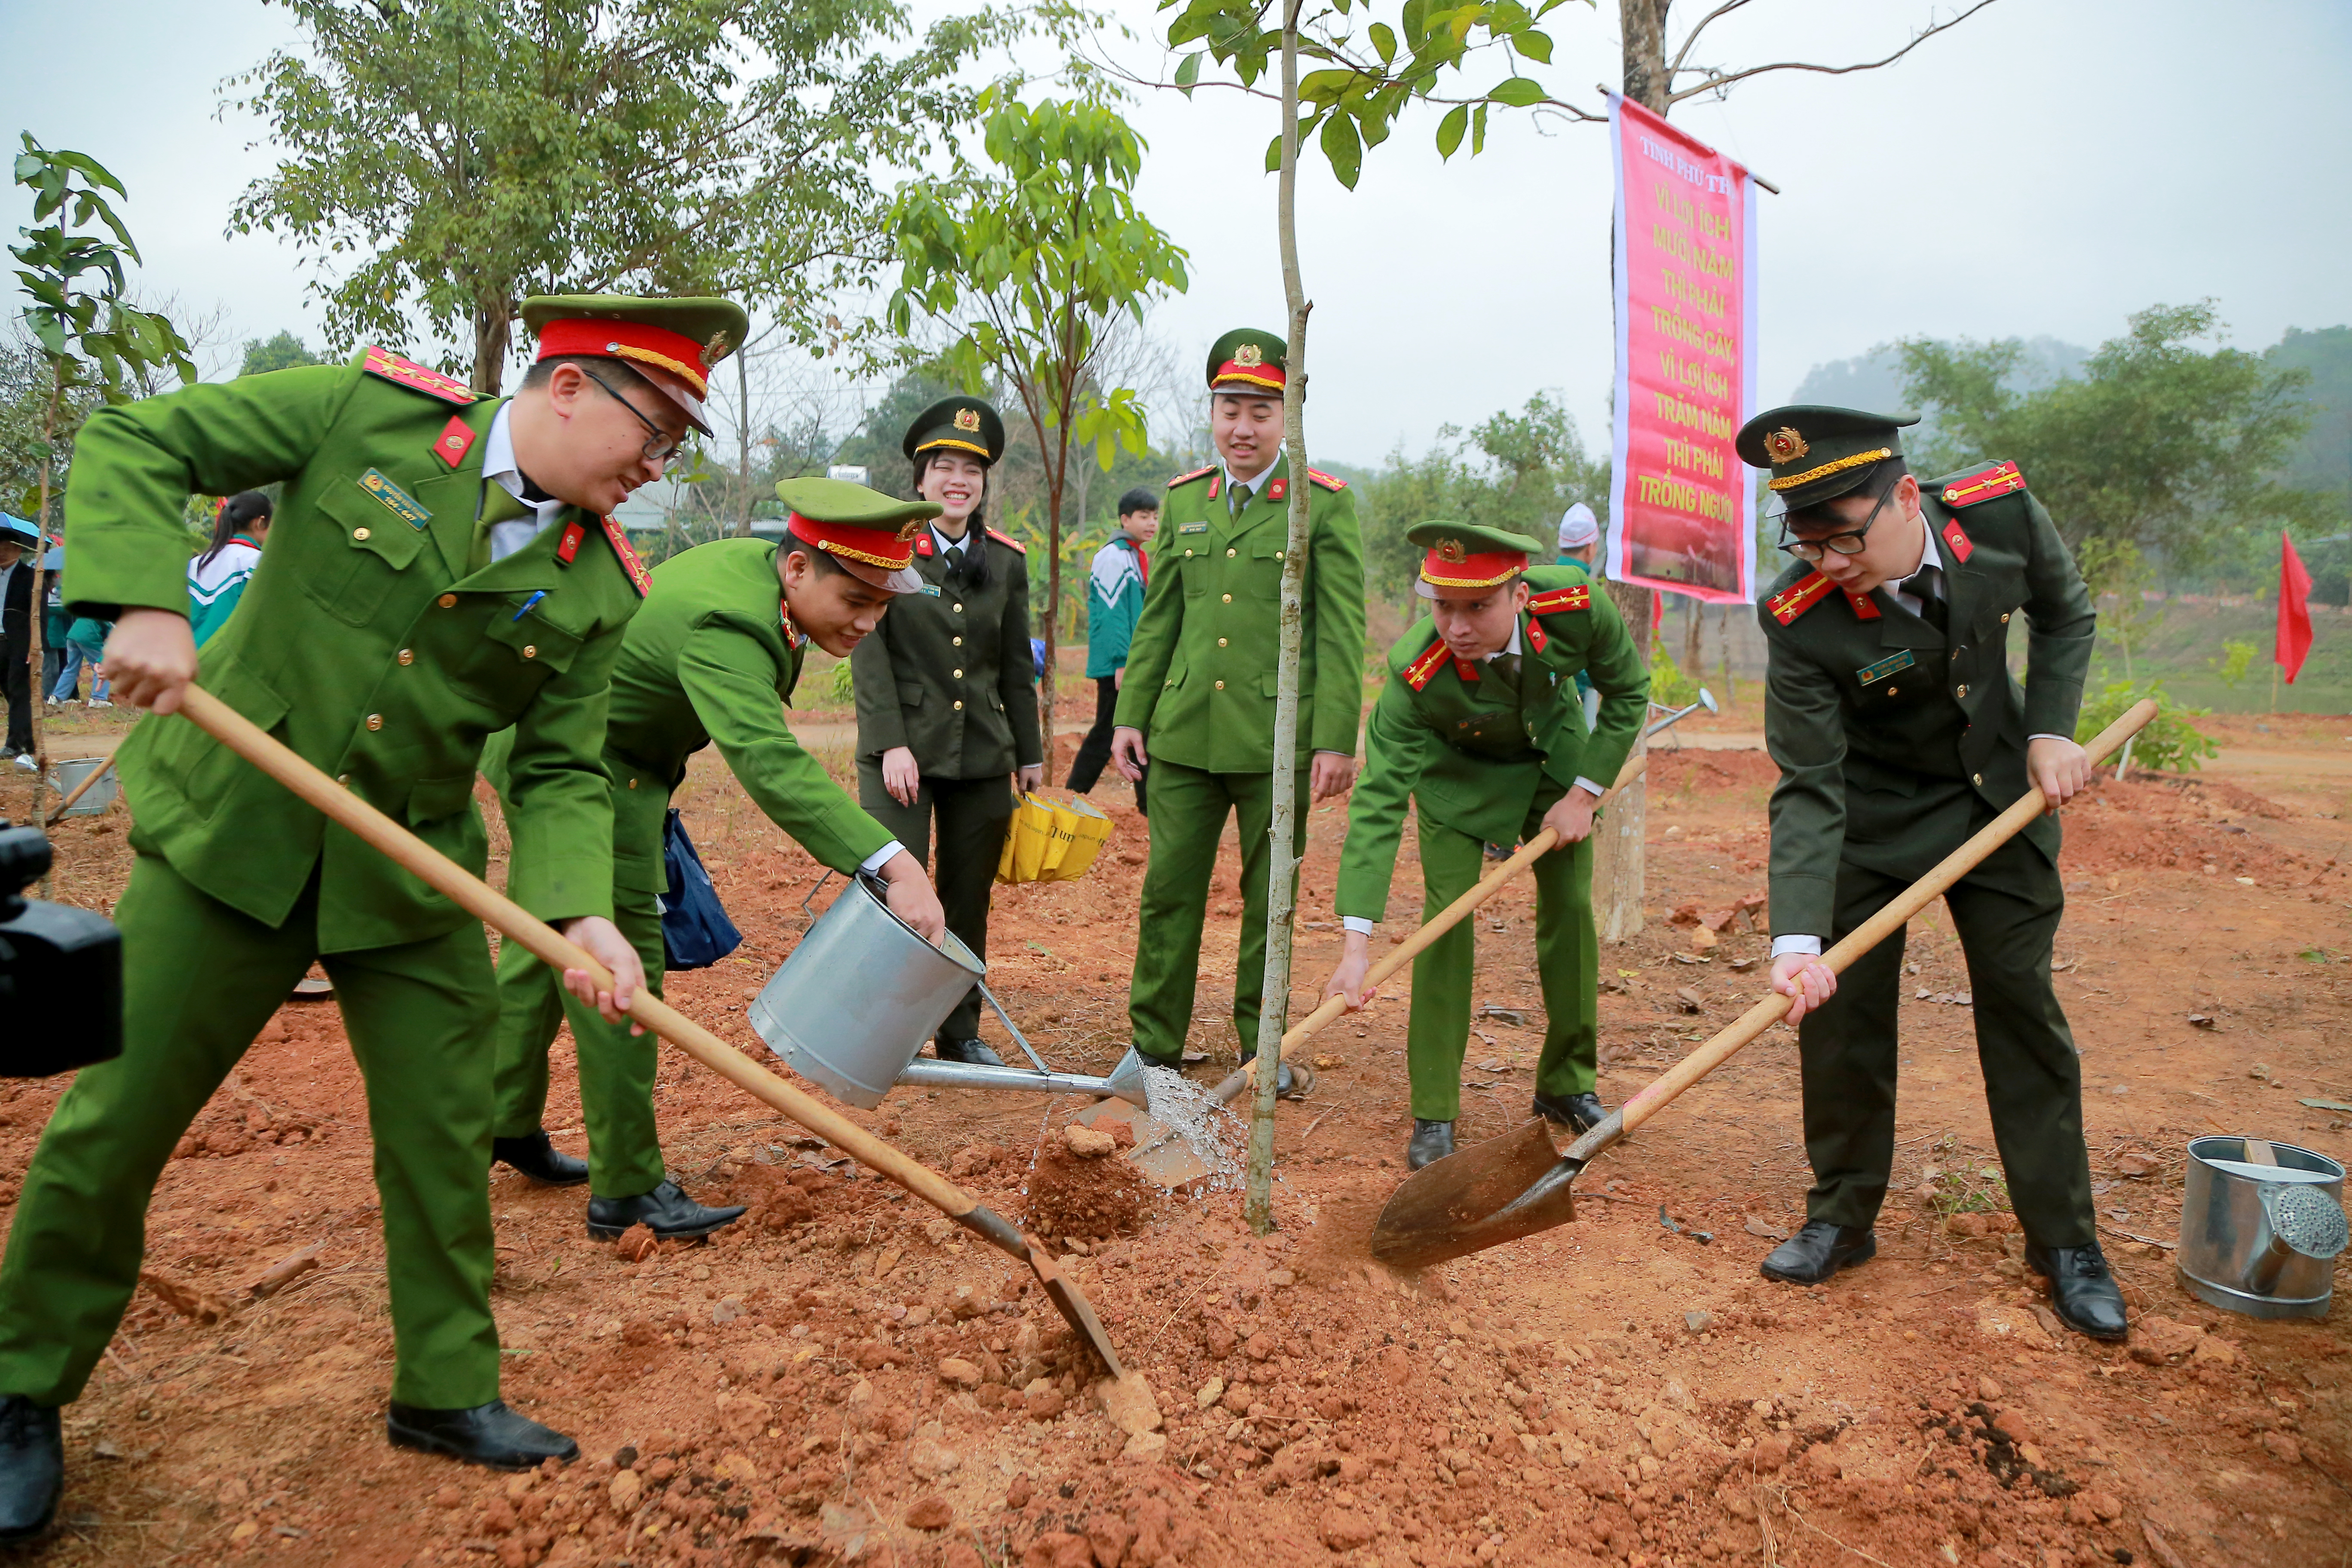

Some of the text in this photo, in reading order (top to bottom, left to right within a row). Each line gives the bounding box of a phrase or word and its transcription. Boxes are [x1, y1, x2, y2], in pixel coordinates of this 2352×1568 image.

[1676, 156, 1704, 186] PHÚ
[1655, 181, 1670, 213] VÌ
[1700, 202, 1730, 242] ÍCH
[1693, 245, 1733, 282] NĂM
[1661, 267, 1725, 319] THÌ PHẢI
[1651, 303, 1702, 349] TRỒNG
[1660, 347, 1729, 401] VÌ LỢI ÍCH
[1654, 391, 1731, 443] TRĂM NĂM
[1664, 435, 1724, 481] THÌ PHẢI
[1638, 468, 1697, 513] TRỒNG
